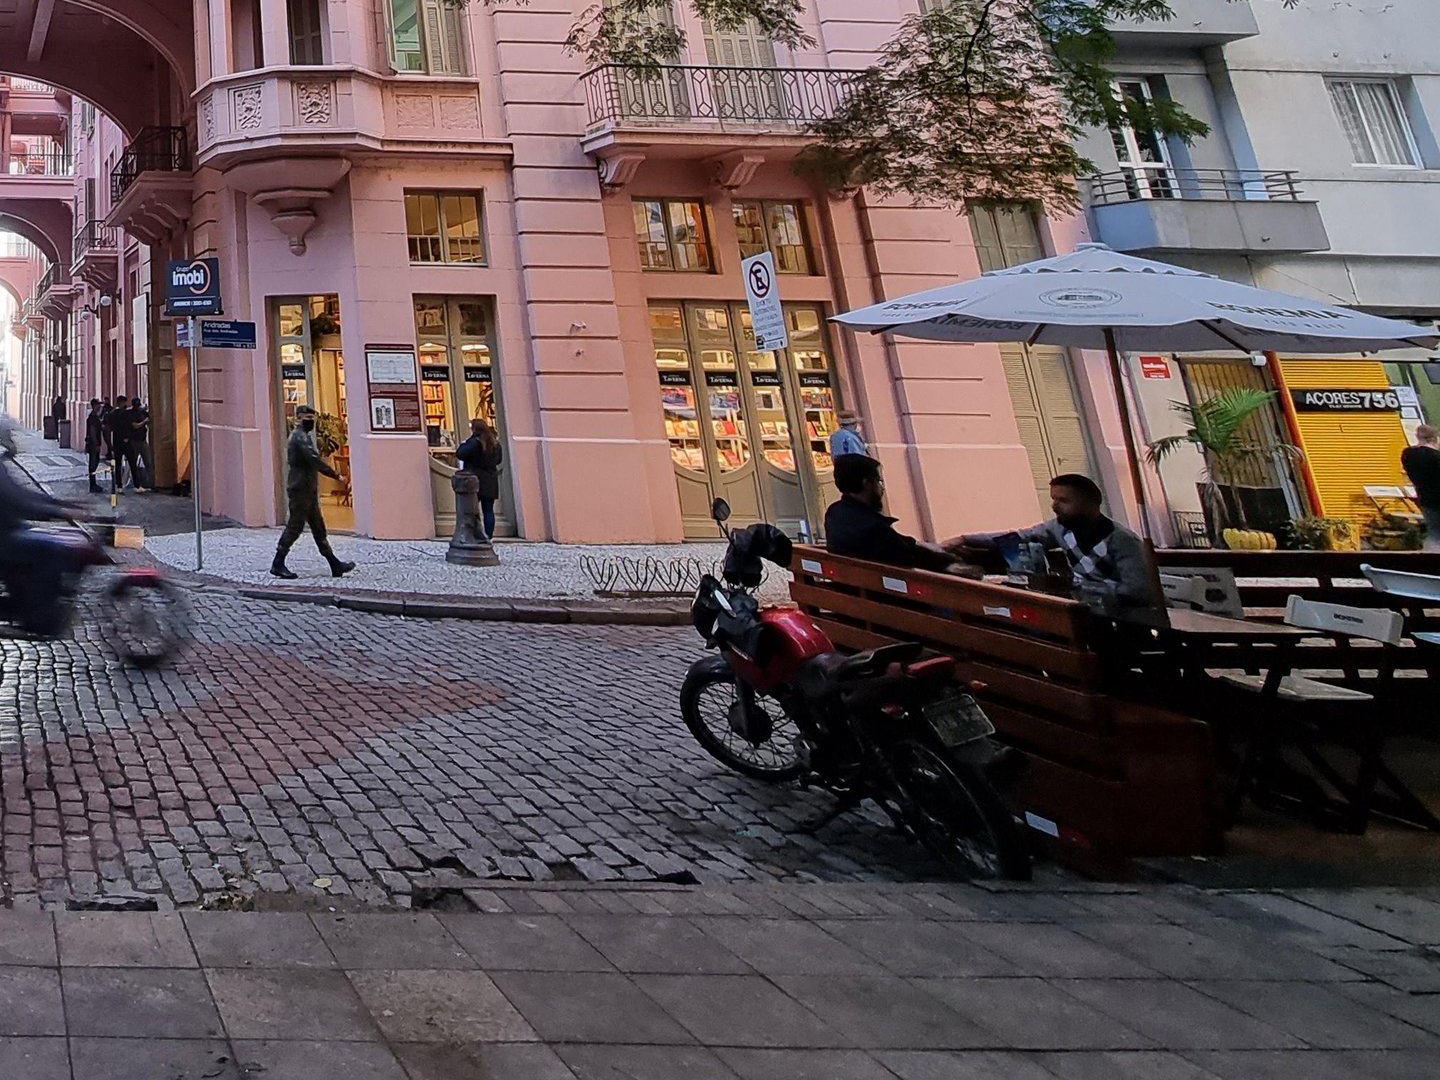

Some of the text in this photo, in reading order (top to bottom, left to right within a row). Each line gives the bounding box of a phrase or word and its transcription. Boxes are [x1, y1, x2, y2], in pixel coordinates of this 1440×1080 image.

[172, 269, 204, 286] imobi
[1205, 301, 1355, 319] BOHEMIA
[1305, 392, 1360, 406] AÇORES
[1360, 392, 1399, 408] 756
